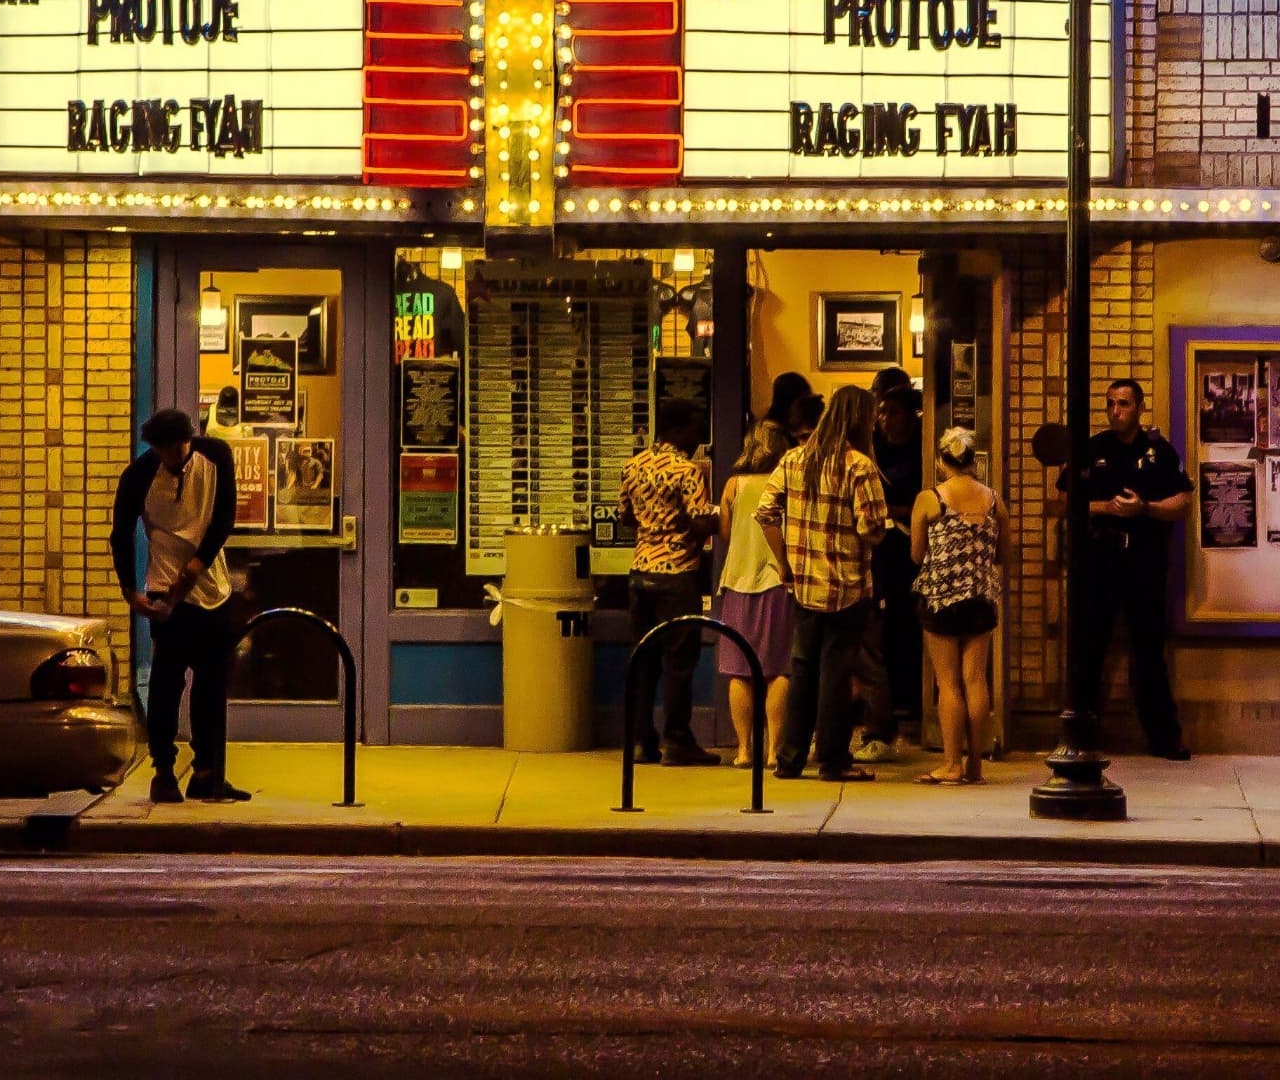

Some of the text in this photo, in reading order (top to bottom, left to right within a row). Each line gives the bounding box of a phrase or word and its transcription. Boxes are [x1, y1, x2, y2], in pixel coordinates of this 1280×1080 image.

[67, 96, 264, 159] RAGING FYAH
[790, 101, 1018, 158] RAGING FYAH
